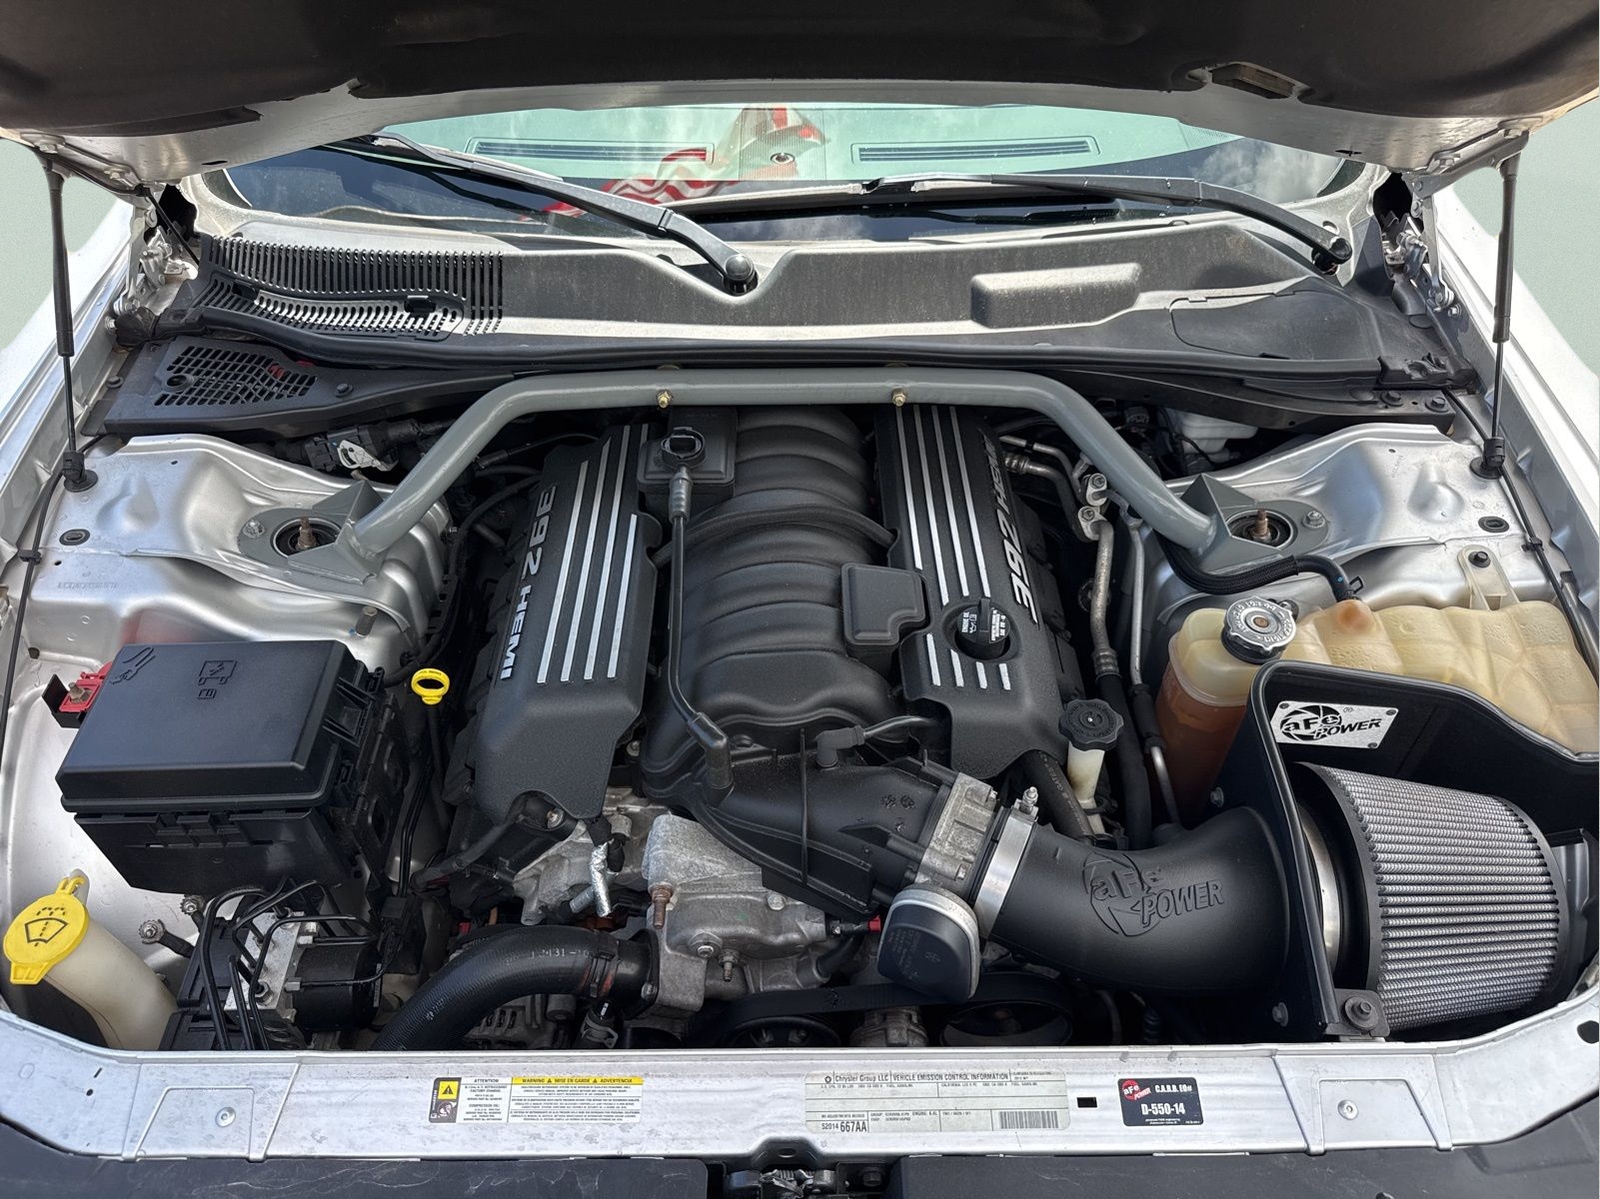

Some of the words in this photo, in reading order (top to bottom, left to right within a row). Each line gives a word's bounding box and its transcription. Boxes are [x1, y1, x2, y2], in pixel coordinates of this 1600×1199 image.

[521, 485, 557, 580] 392
[997, 508, 1039, 625] 392
[500, 585, 532, 680] HEMI
[1284, 715, 1340, 732] aFe
[1313, 718, 1383, 740] POWER
[1141, 879, 1225, 928] POWER
[835, 1075, 858, 1083] Chrysler
[860, 1074, 877, 1083] Group
[917, 1073, 942, 1081] EMISSION
[944, 1073, 969, 1081] CONTROL
[1123, 1084, 1140, 1095] aFe
[1141, 1103, 1186, 1115] D-550-14
[840, 1121, 867, 1132] 667AA
